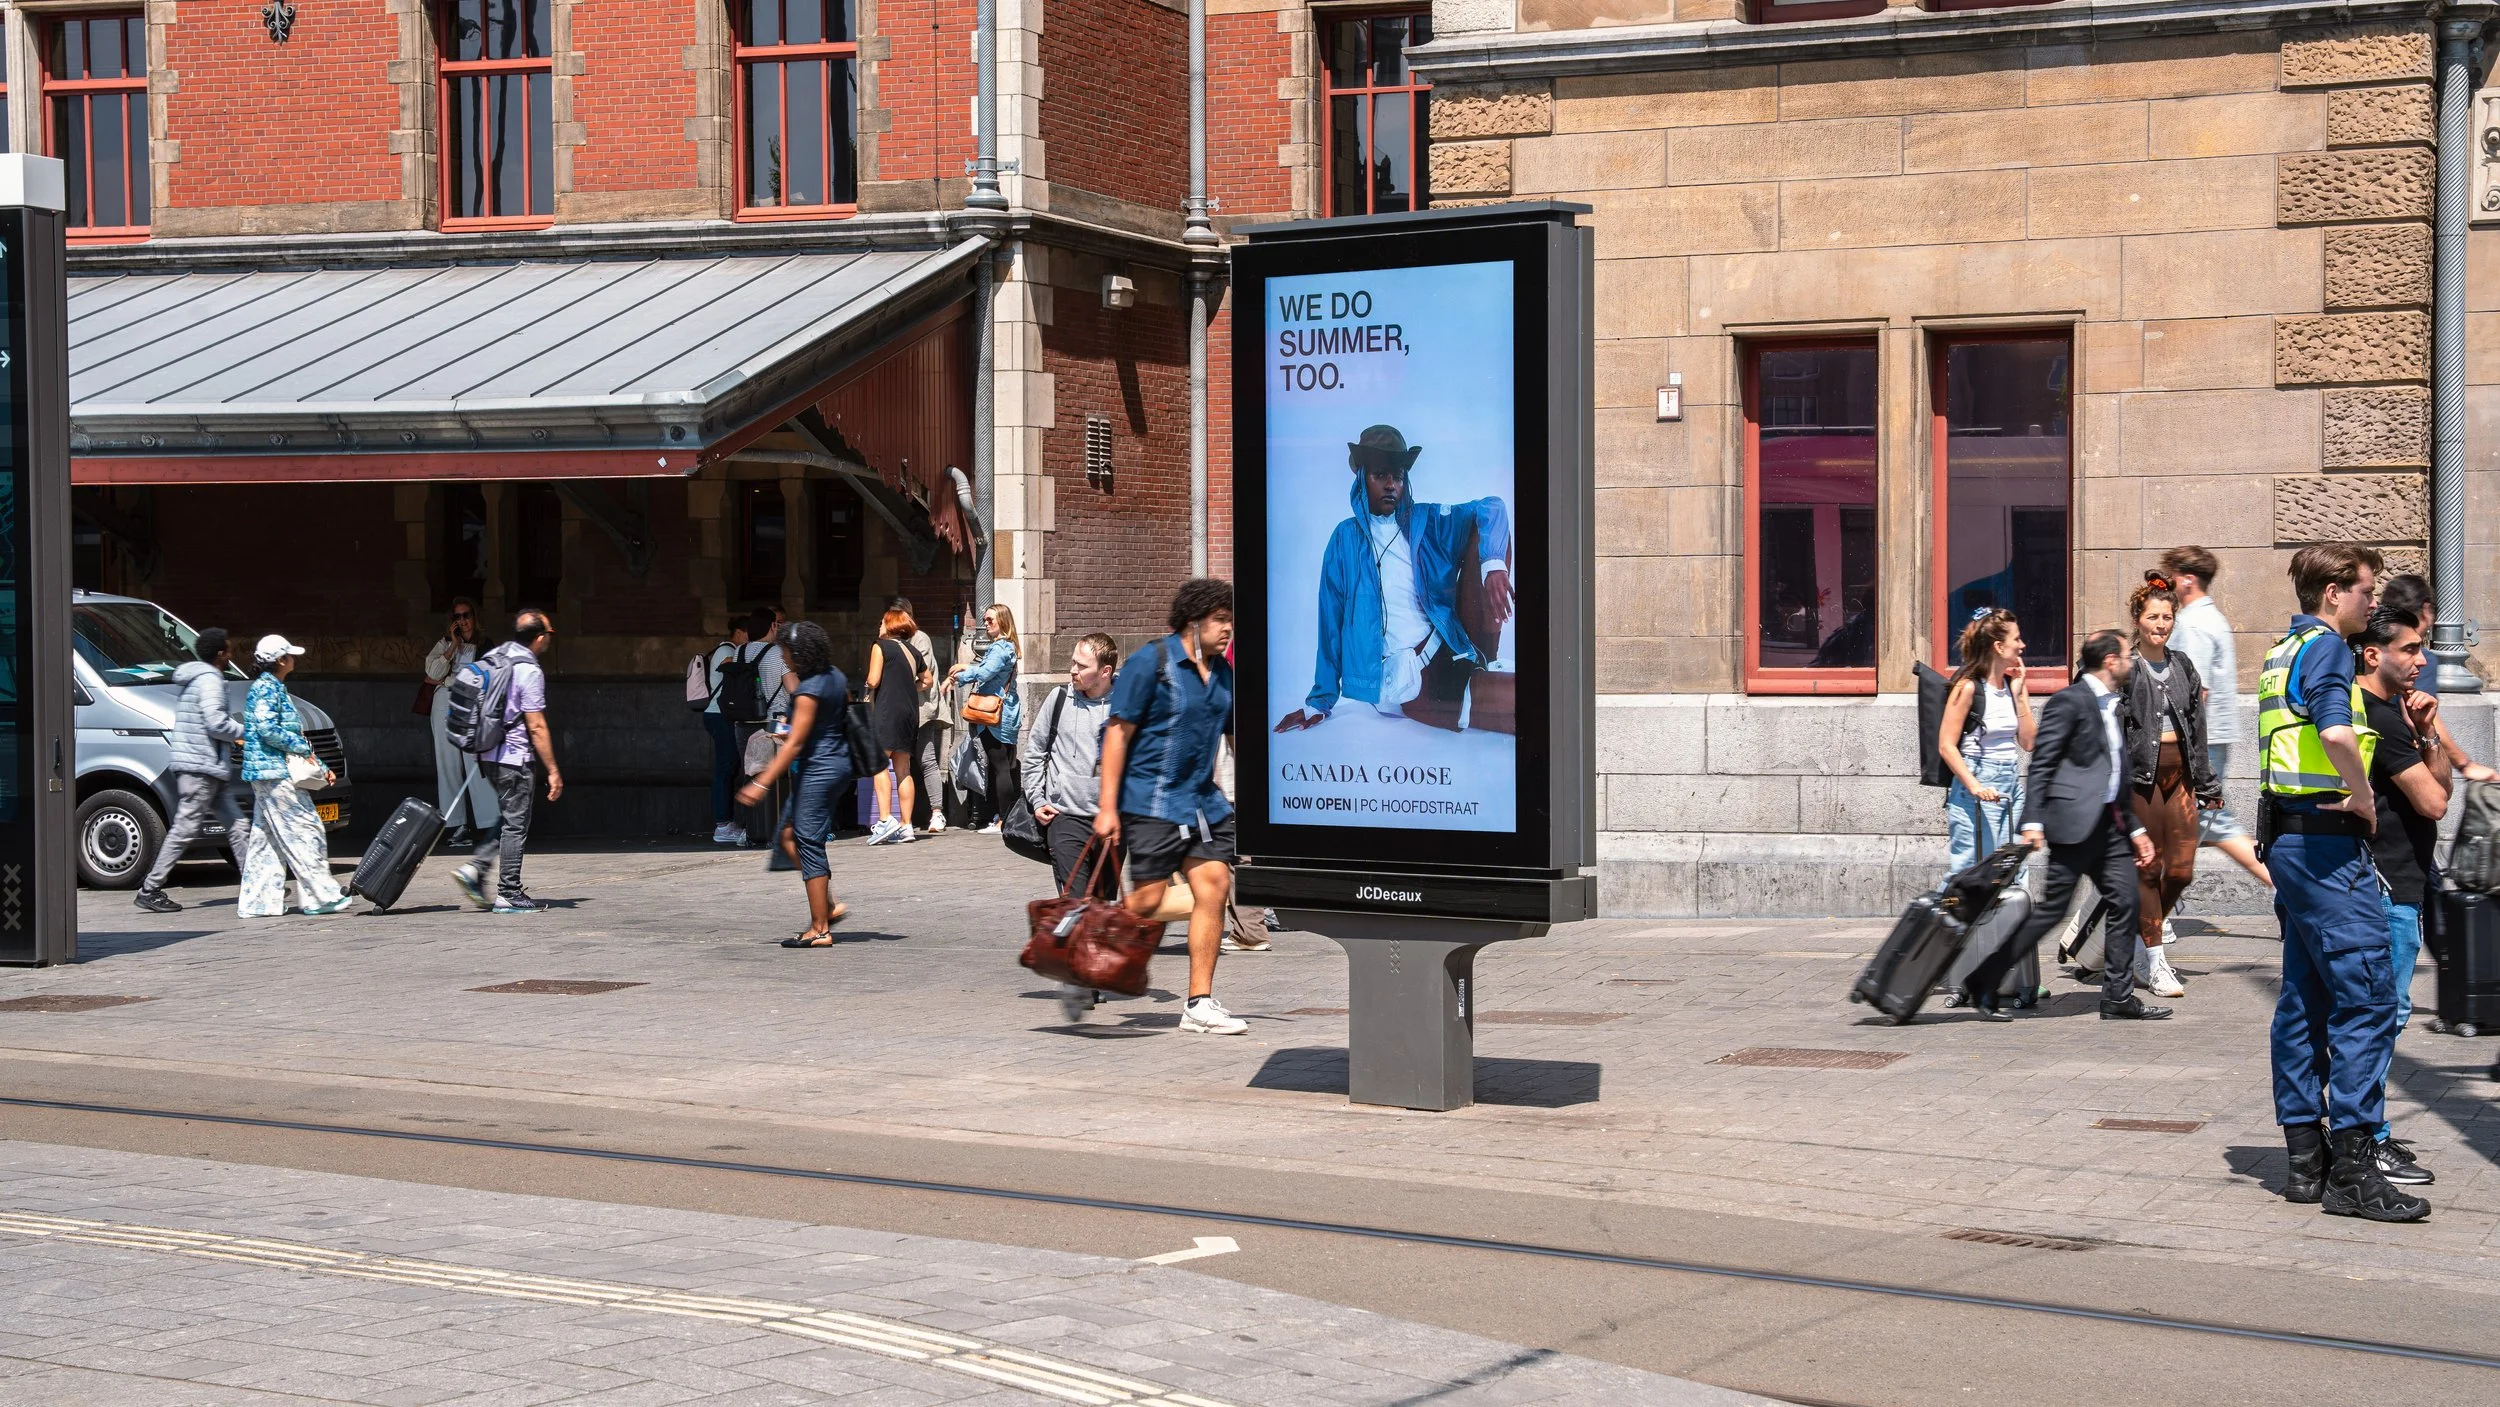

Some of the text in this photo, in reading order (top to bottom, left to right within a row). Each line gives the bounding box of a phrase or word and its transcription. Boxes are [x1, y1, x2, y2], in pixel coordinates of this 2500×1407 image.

[1279, 290, 1372, 322] WE DO
[1279, 324, 1410, 357] SUMMER,
[1279, 362, 1344, 391] TOO.
[1281, 763, 1452, 785] CANADA GOOSE
[1282, 796, 1313, 810] NOW
[1316, 797, 1351, 811] OPEN
[1361, 799, 1378, 812] PC
[1381, 799, 1479, 815] HOOFDSTRAAT
[1356, 886, 1422, 902] JCDecaux
